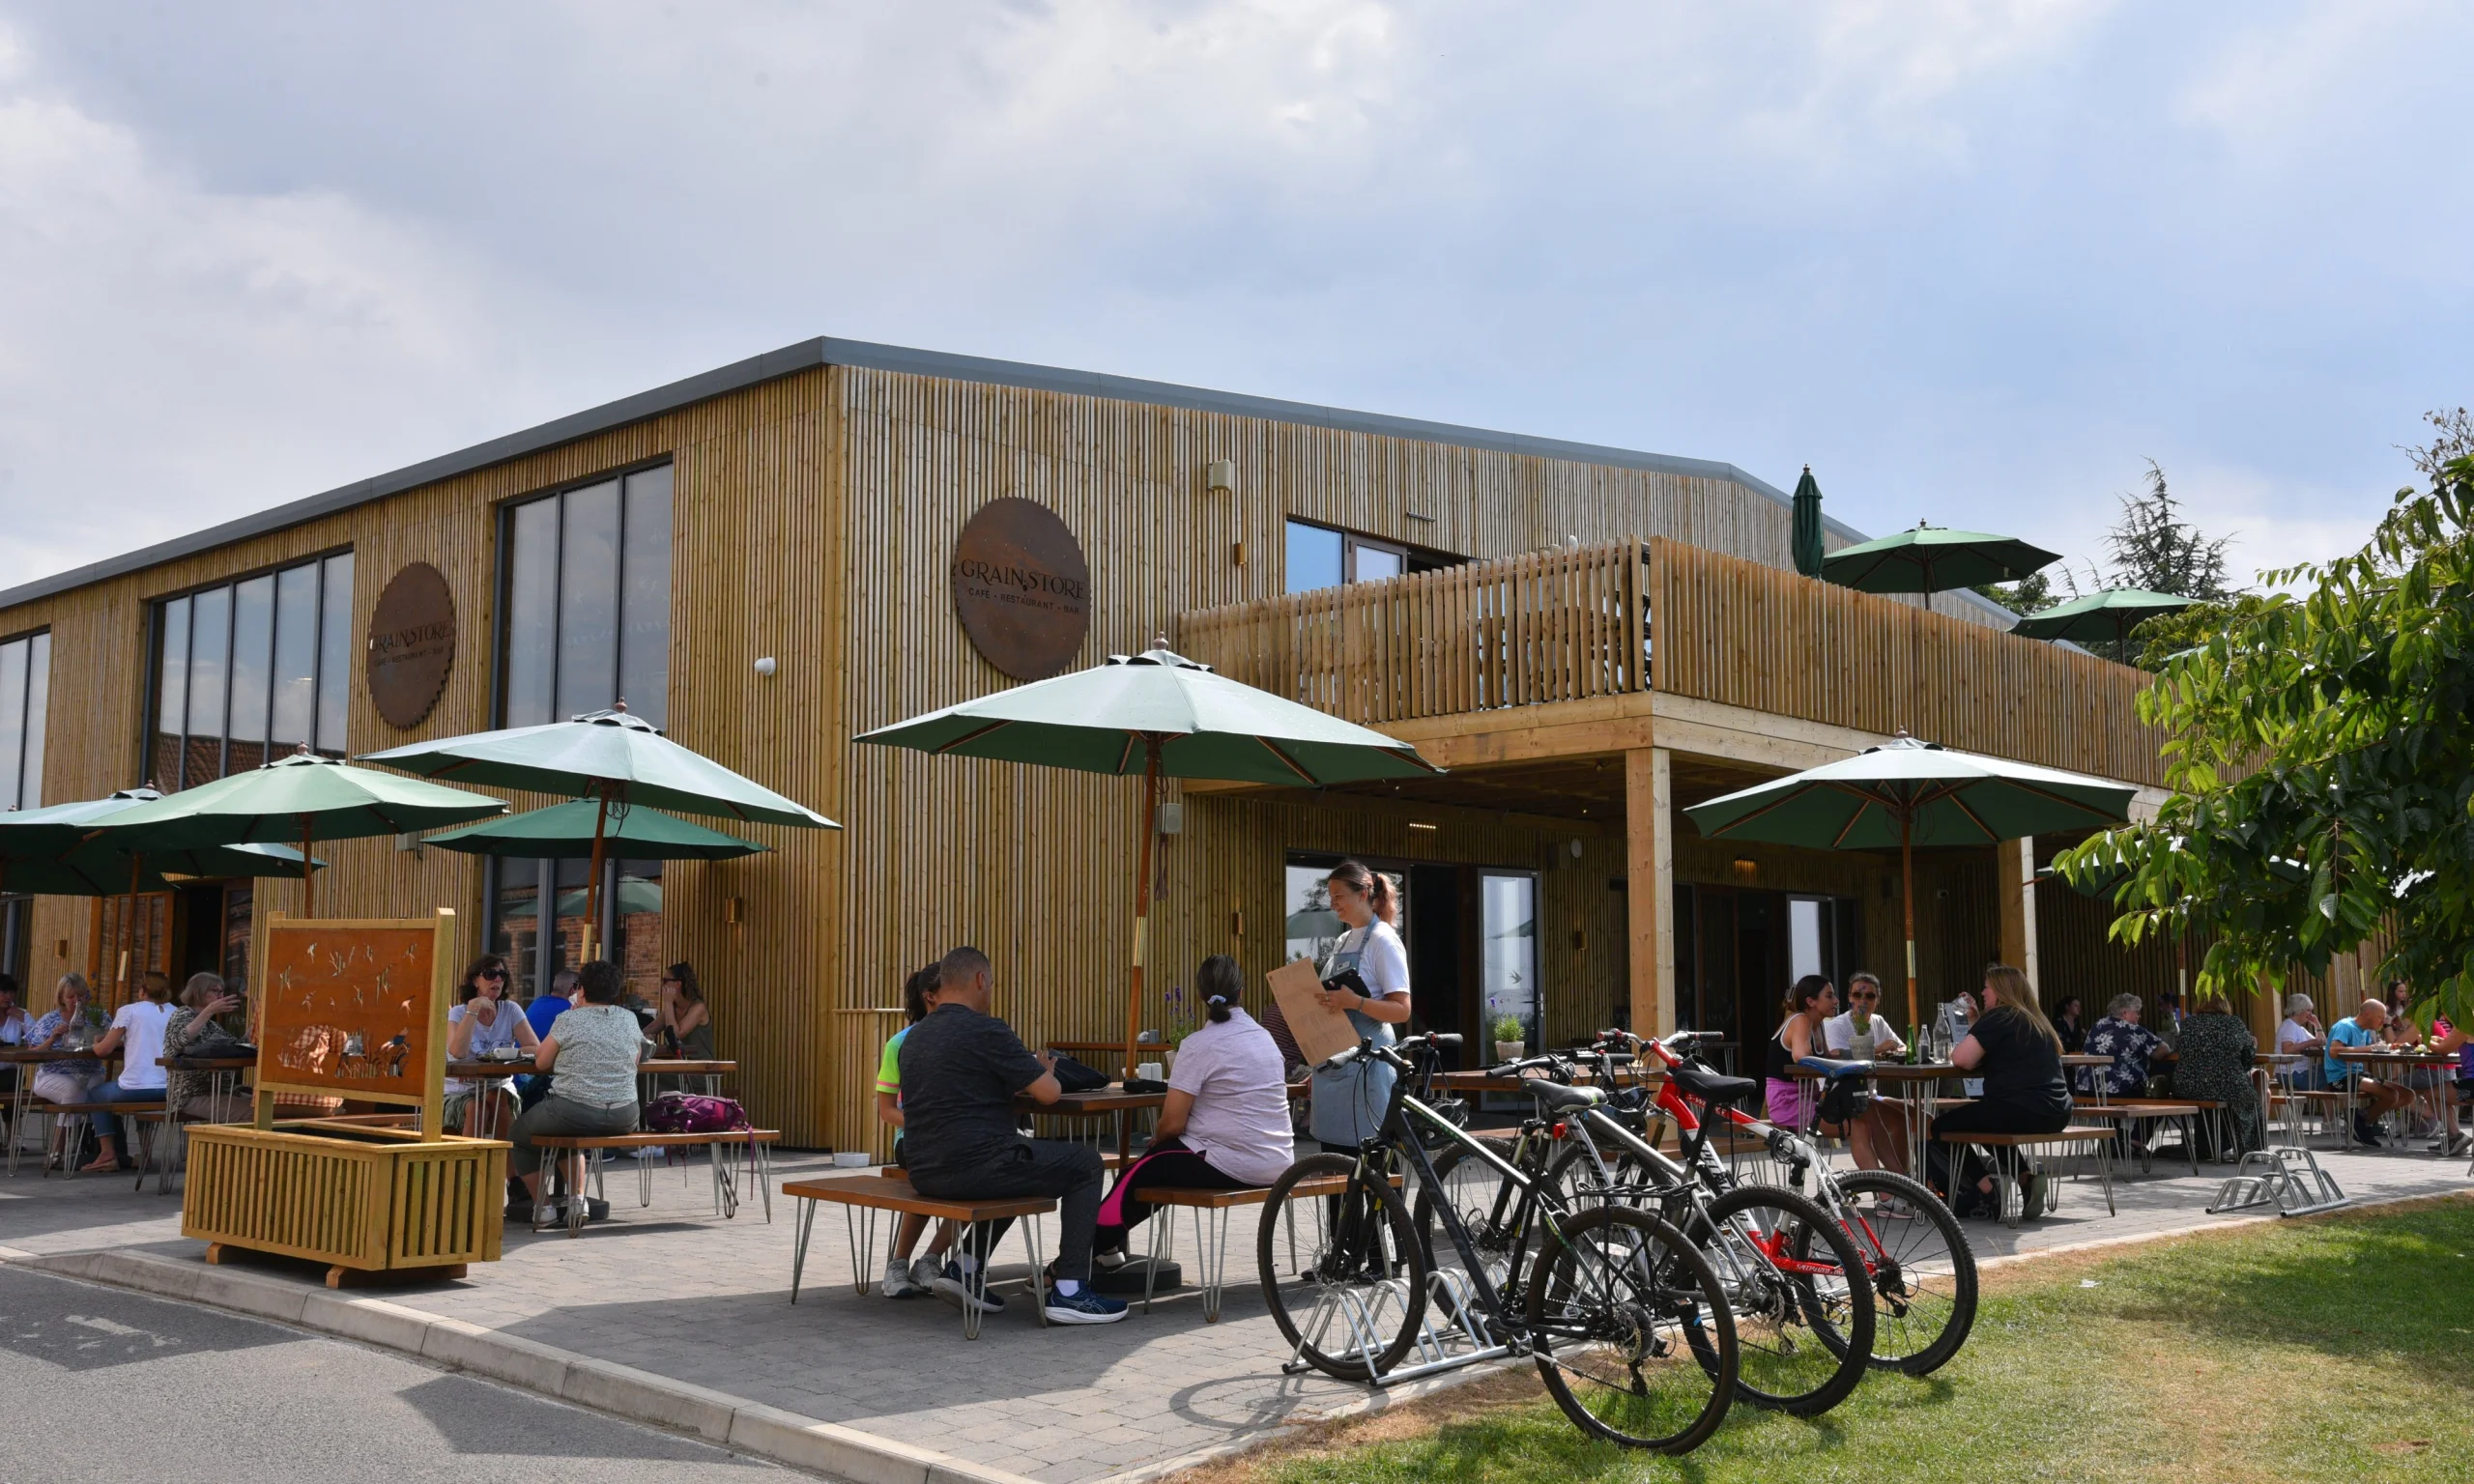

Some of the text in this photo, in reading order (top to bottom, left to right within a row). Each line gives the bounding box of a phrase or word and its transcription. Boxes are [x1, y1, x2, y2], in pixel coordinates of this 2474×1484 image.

[961, 558, 1086, 601] GRAINSTORE
[968, 587, 1079, 615] CAFÉ RESTAURANT BAR
